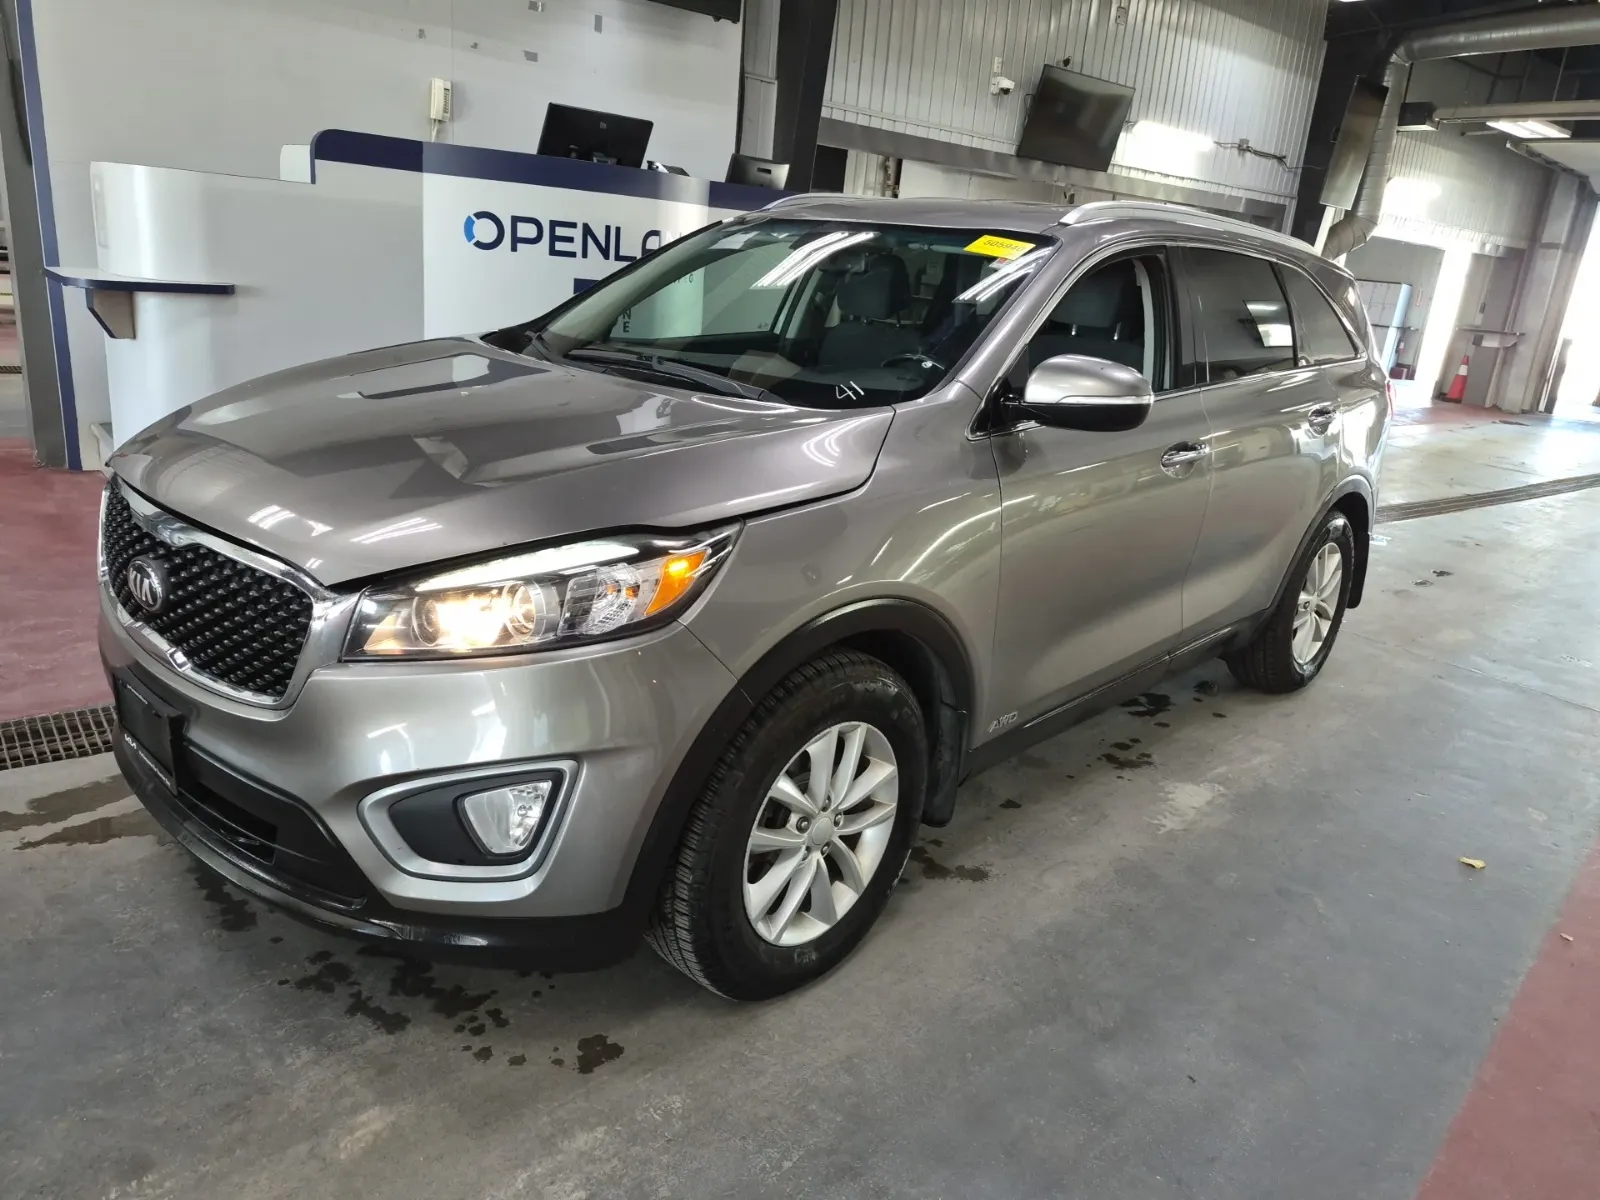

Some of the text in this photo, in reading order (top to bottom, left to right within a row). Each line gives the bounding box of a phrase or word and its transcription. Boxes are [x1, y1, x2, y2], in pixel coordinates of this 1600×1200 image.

[463, 210, 684, 263] OPENLA
[835, 380, 865, 400] 41
[130, 567, 154, 605] KIA
[988, 711, 1018, 733] AWD
